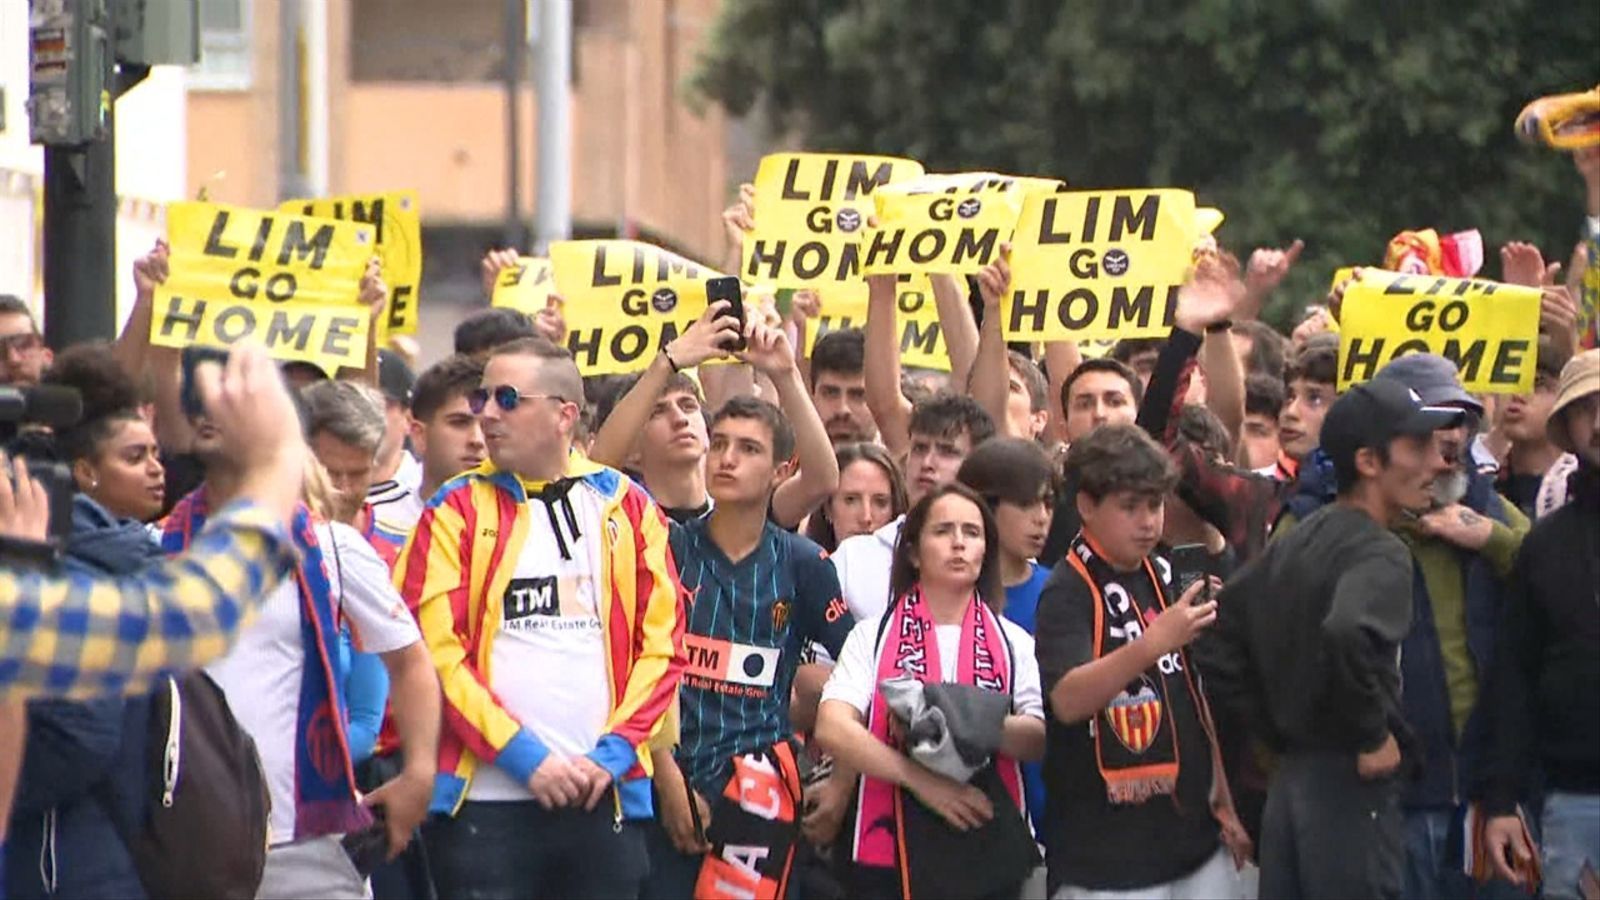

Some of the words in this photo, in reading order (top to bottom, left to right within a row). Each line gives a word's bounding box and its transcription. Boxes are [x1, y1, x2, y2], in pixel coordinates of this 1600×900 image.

[782, 159, 892, 201] LIM
[1038, 195, 1160, 244] LIM
[204, 211, 335, 270] LIM
[229, 267, 298, 303] GO
[592, 246, 698, 287] LIM
[160, 296, 359, 357] HOME
[1406, 300, 1469, 332] GO
[512, 585, 553, 613] TM
[686, 645, 719, 670] TM
